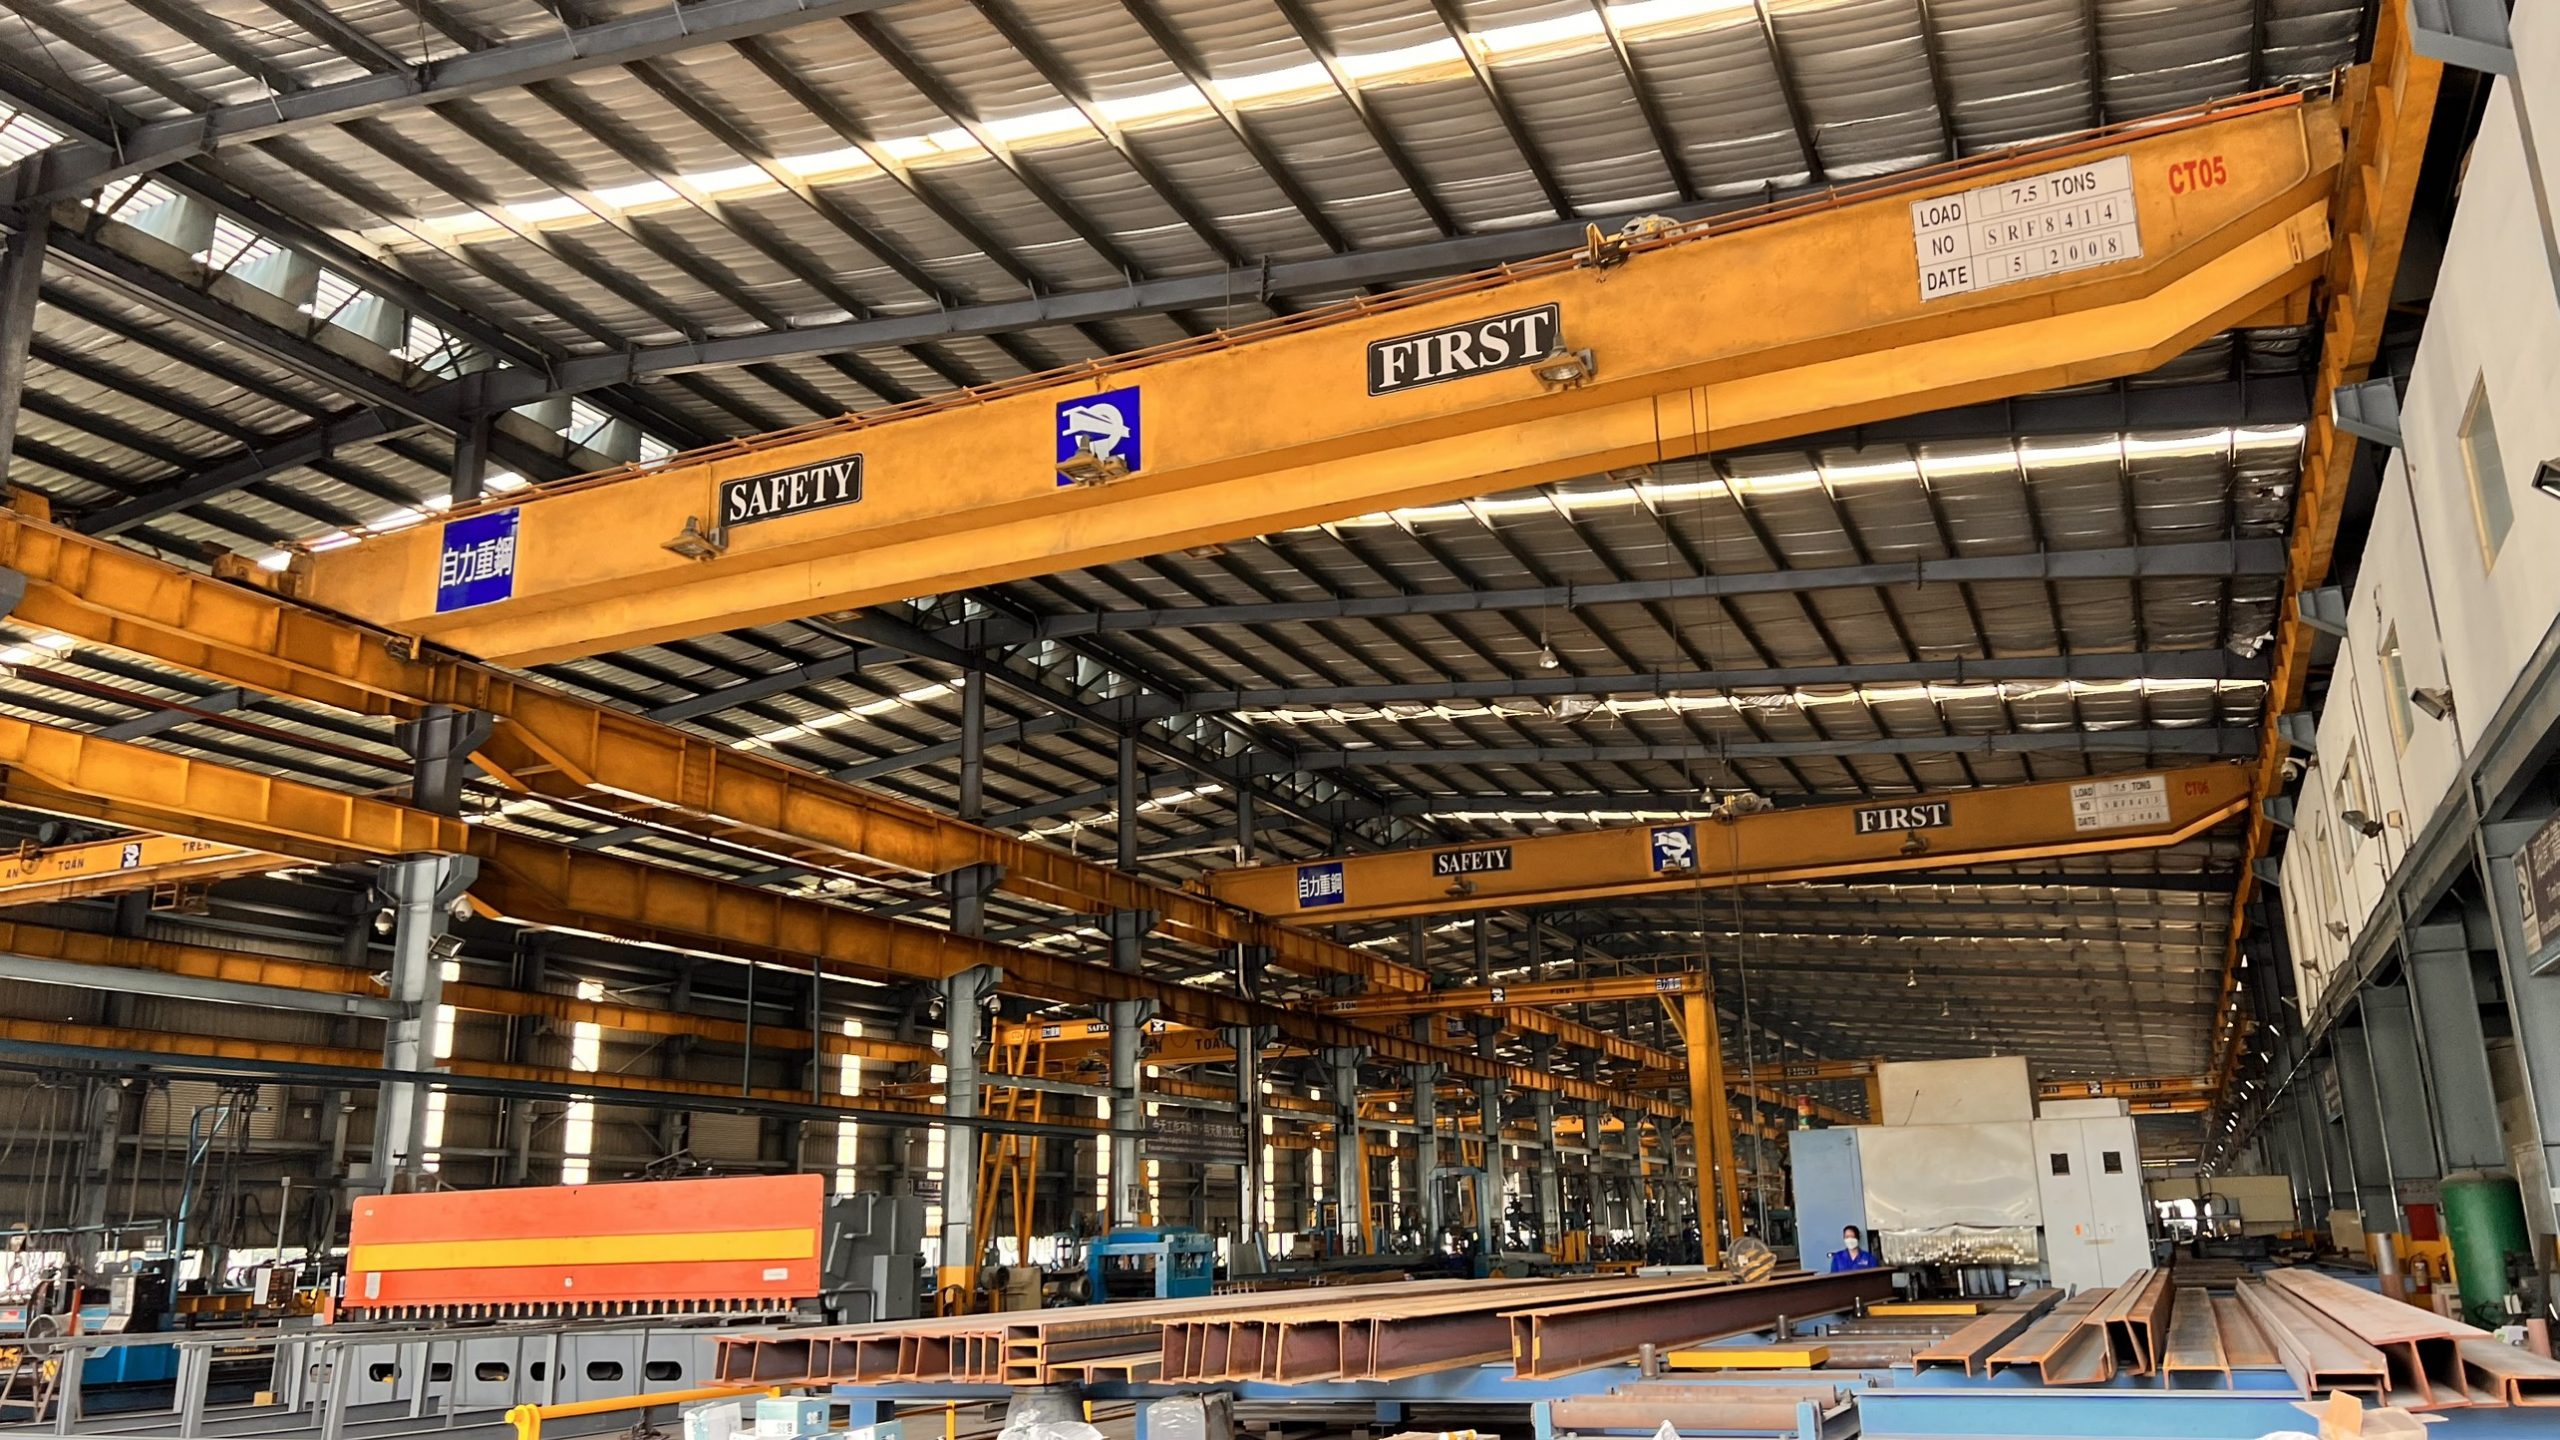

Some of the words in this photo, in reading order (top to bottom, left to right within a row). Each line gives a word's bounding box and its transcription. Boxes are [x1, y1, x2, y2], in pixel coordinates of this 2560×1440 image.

[2168, 155, 2228, 196] CT05
[1919, 203, 1963, 229] LOAD
[2011, 184, 2039, 206] 7.5
[2050, 171, 2097, 199] TONS
[1931, 235, 1956, 257] NO
[1926, 266, 1969, 292] DATE
[2012, 256, 2023, 273] 5
[1377, 311, 1551, 390] FIRST
[729, 461, 856, 522] SAFETY
[439, 535, 516, 589] 自力重鋼
[2073, 787, 2094, 798] LOAD
[2131, 780, 2151, 791] TONS
[1859, 804, 1947, 832] FIRST
[2080, 801, 2091, 811] NO
[2078, 816, 2096, 827] DATE
[1438, 849, 1508, 874] SAFETY
[1299, 872, 1343, 898] 自力重鋼
